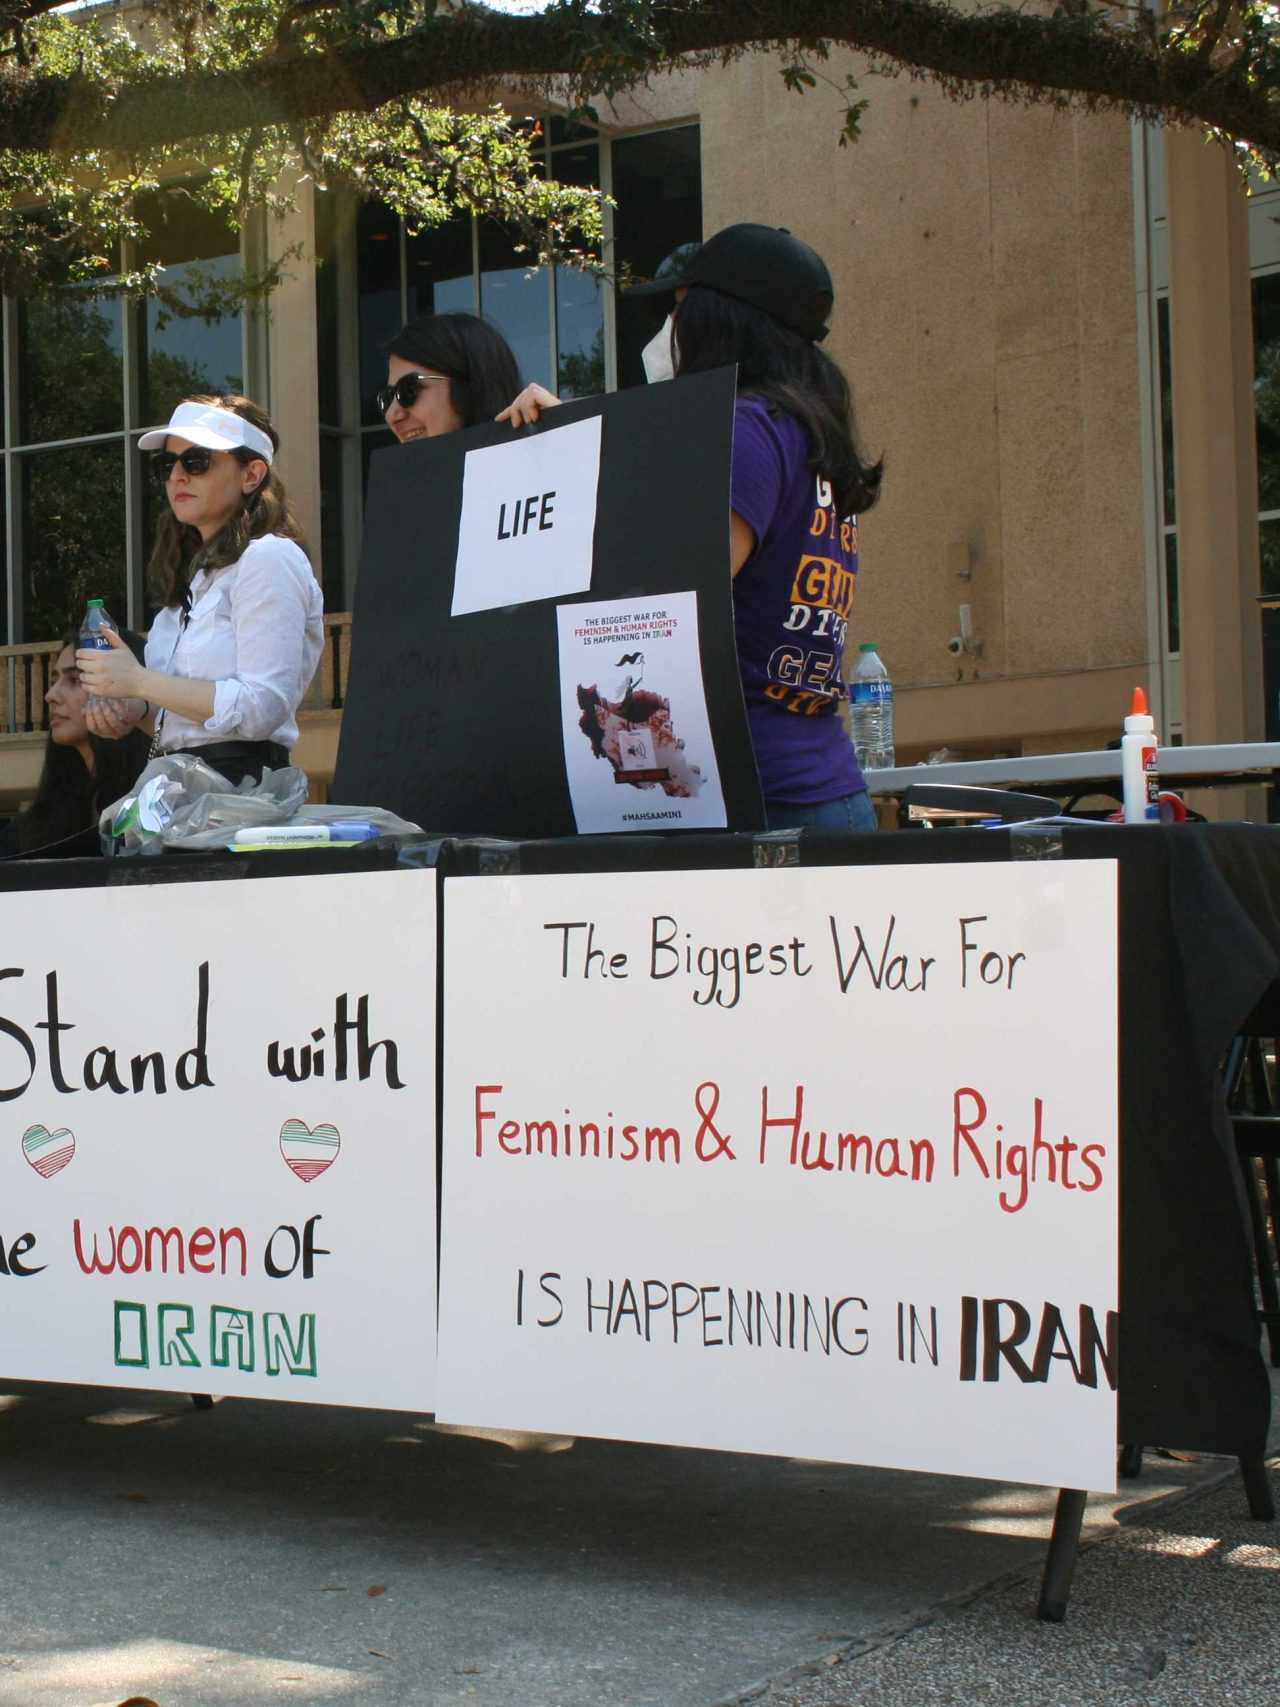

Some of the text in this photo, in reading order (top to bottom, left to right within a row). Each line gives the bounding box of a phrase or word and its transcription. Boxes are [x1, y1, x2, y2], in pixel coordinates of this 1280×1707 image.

[497, 491, 556, 540] LIFE
[575, 619, 678, 637] FEMINISM & HUMAN RIGHTS
[583, 637, 591, 645] IS
[642, 631, 651, 639] IN
[652, 629, 672, 639] IRAN
[584, 610, 667, 627] THE BIGGEST WAR FOR
[544, 915, 1026, 1008] The Biggest War For
[267, 992, 406, 1089] with
[475, 1081, 1106, 1213] Feminism & Human Rights
[73, 1219, 247, 1275] women
[264, 1215, 331, 1279] of
[517, 1269, 1117, 1391] IS HAPPENNING IN IRAN
